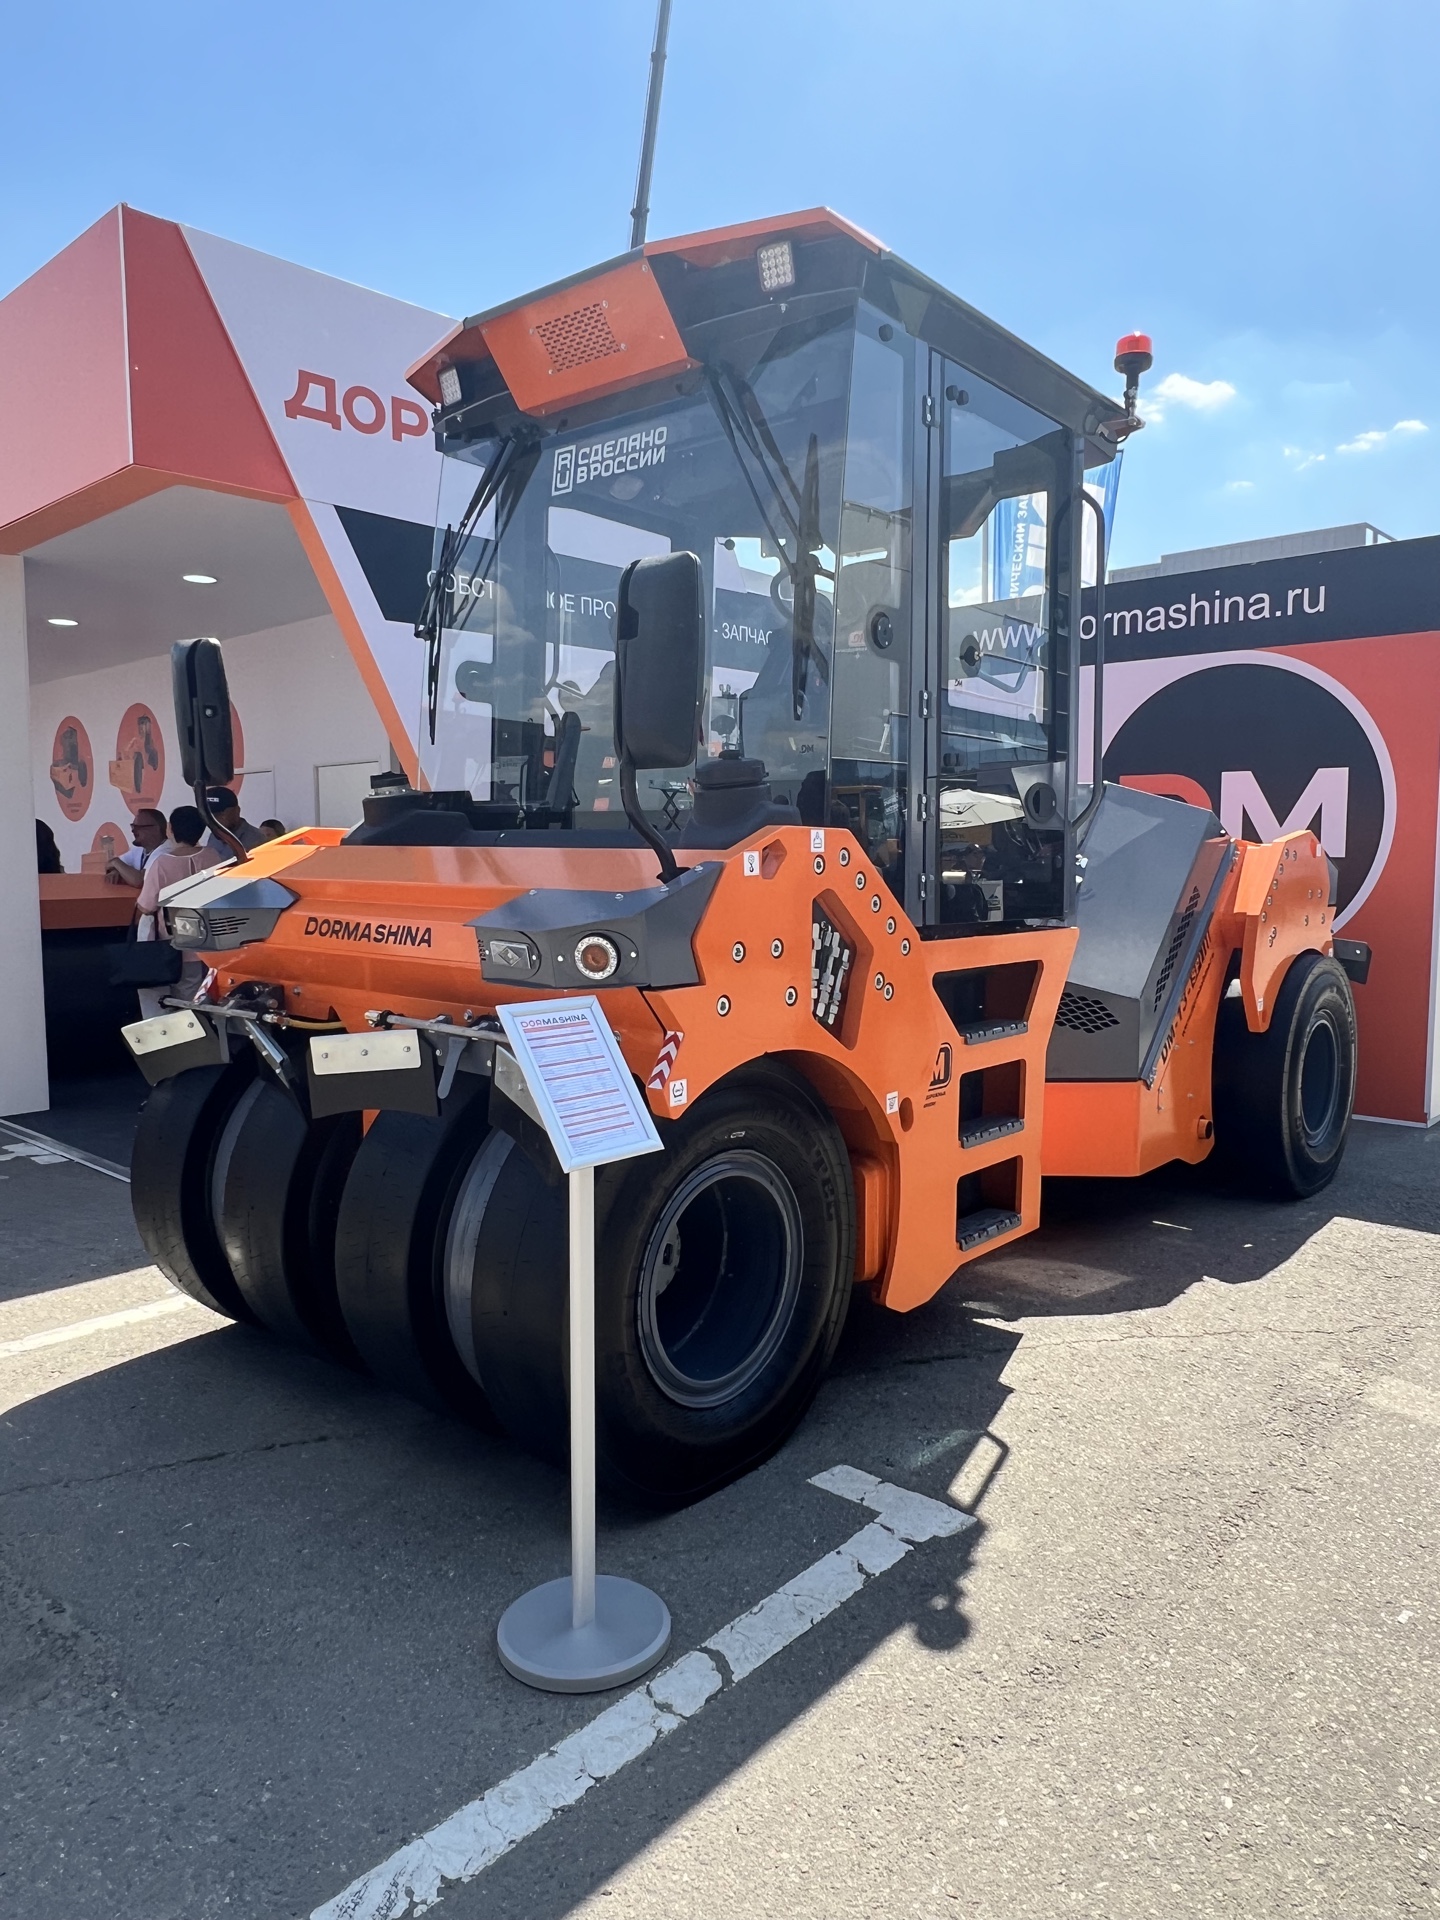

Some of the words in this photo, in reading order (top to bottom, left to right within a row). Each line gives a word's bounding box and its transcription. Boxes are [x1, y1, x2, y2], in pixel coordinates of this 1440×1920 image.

[578, 426, 668, 465] СДЕЛАНО
[304, 916, 432, 948] DORMASHINA
[520, 1013, 588, 1028] DORMASHINA
